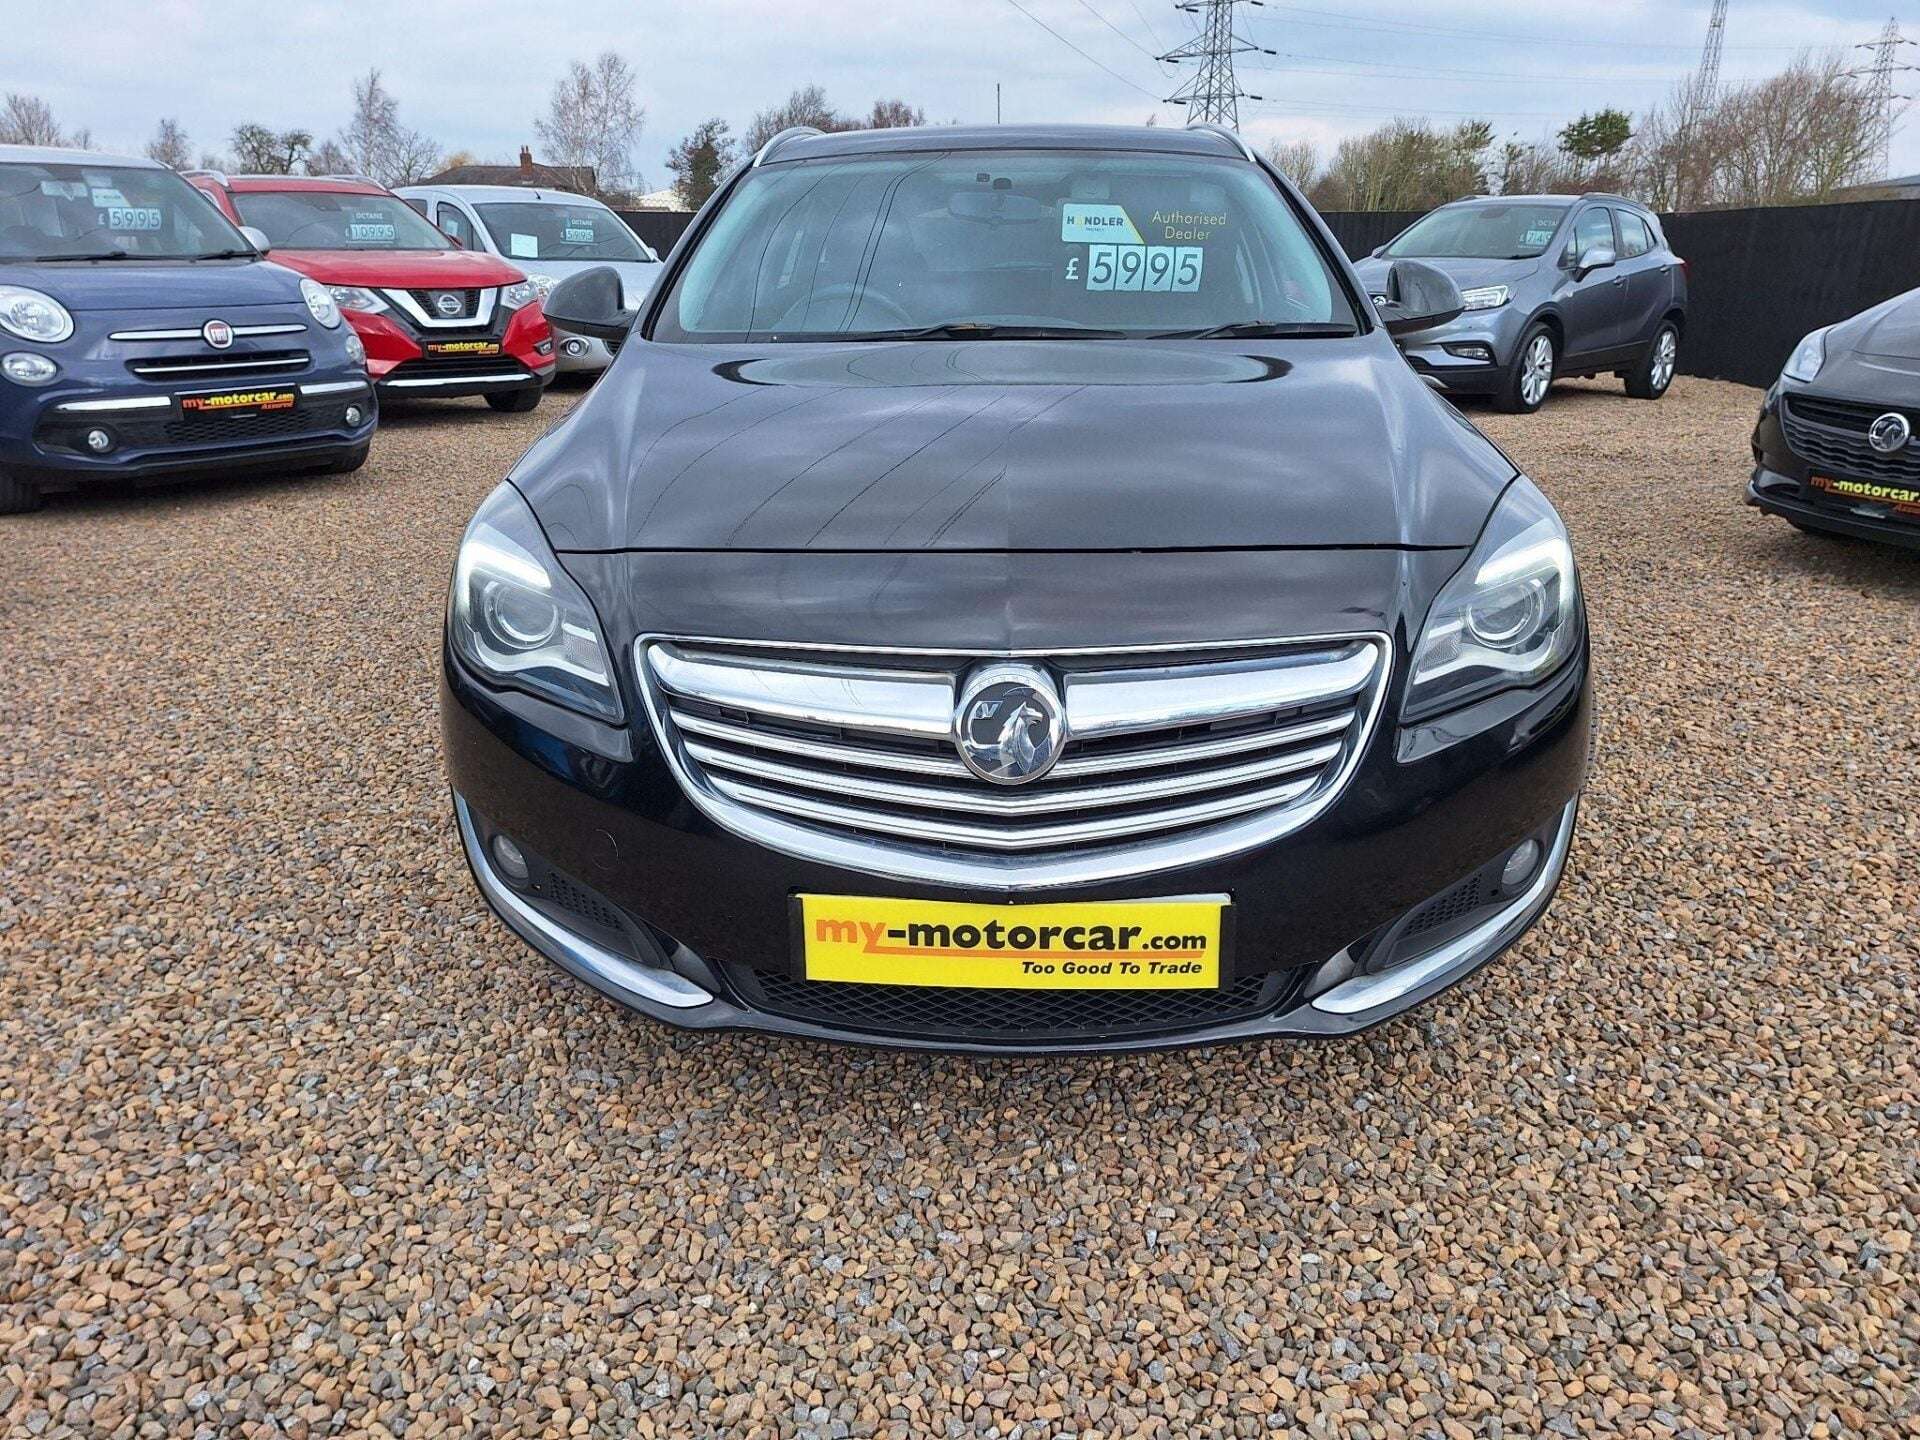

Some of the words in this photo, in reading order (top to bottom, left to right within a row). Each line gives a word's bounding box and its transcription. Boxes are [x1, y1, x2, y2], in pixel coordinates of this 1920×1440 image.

[112, 211, 160, 227] 5995
[1066, 215, 1124, 227] HNDLER
[1152, 211, 1227, 225] Authorised
[1165, 226, 1211, 240] Dealer
[1092, 251, 1198, 286] 5995
[815, 918, 1208, 954] my-motorcar.com
[1022, 960, 1056, 975] Too
[1062, 960, 1112, 975] Good
[1119, 960, 1142, 975] To
[1148, 960, 1203, 975] Trade
